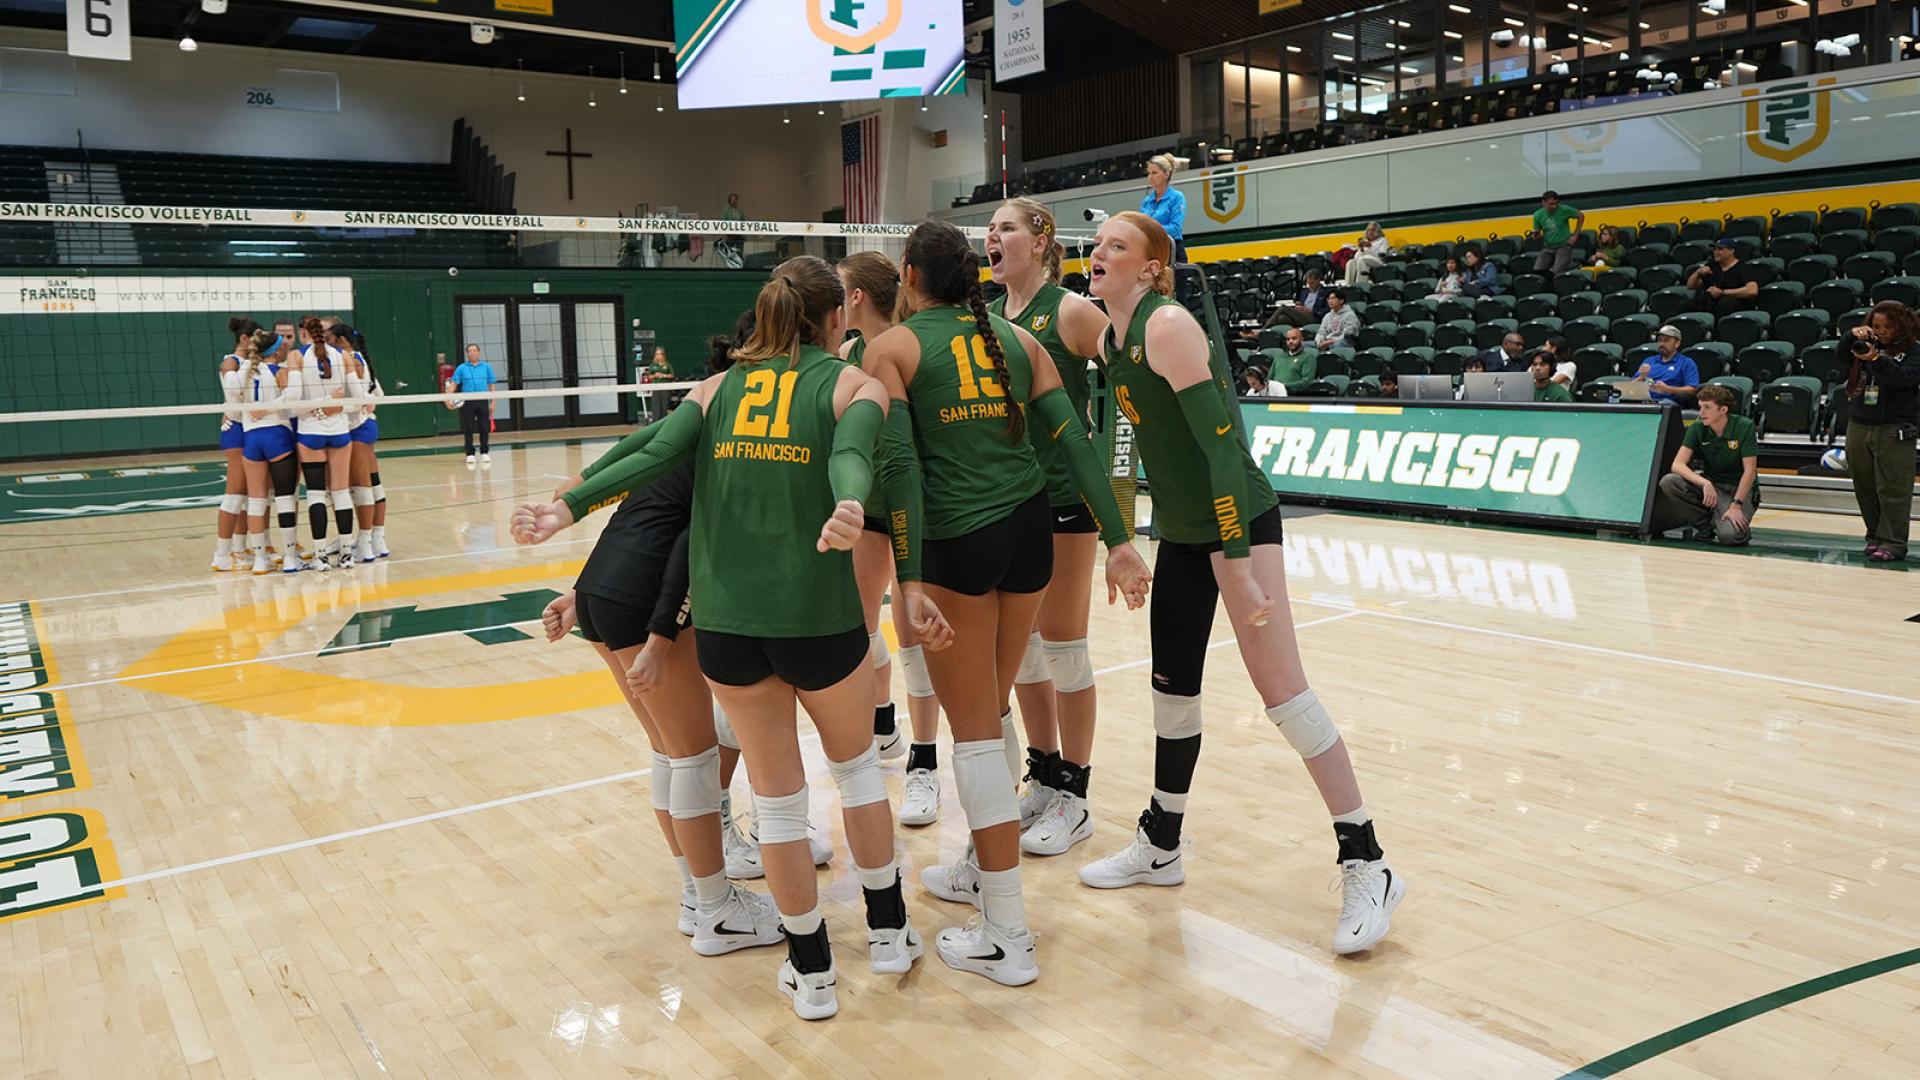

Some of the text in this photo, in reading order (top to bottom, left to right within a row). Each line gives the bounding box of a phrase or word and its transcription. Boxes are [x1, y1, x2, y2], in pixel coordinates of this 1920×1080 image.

[1007, 27, 1030, 45] 1955
[247, 91, 274, 105] 206
[1, 203, 252, 221] SAN FRANCISCO VOLLEYBALL
[345, 213, 544, 227] SAN FRANCISCO VOLLEYBALL
[618, 219, 779, 232] SAN FRANCISCO VOLLEYBALL
[839, 224, 859, 234] SAN
[20, 287, 96, 302] FRANCISCO
[732, 368, 799, 438] 21
[940, 405, 968, 423] SAN
[714, 441, 811, 464] SAN FRANCISCO
[1250, 425, 1581, 496] FRANCISCO
[1213, 495, 1243, 541] DONS
